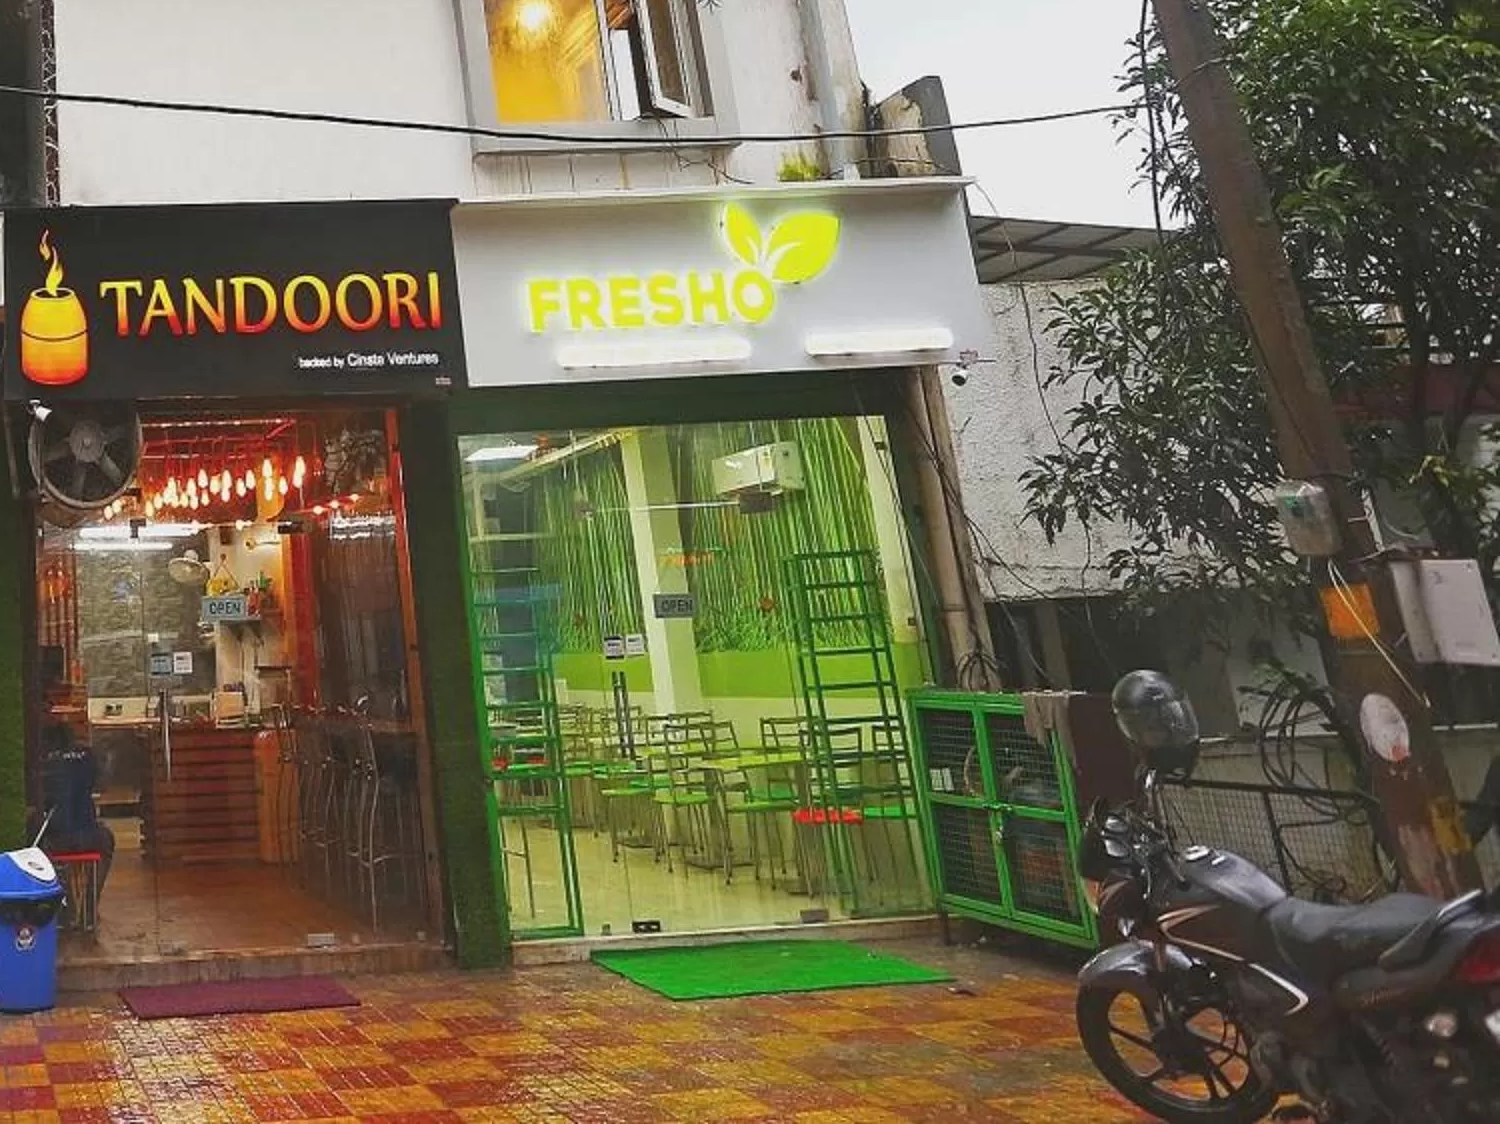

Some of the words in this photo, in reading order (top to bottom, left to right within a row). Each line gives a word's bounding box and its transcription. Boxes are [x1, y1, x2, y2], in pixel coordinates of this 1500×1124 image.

[100, 271, 443, 337] TANDOORI
[528, 269, 775, 333] FRESHO
[333, 357, 345, 369] by
[387, 351, 439, 366] Ventures
[209, 601, 241, 615] OPEN
[661, 599, 693, 613] OPEN
